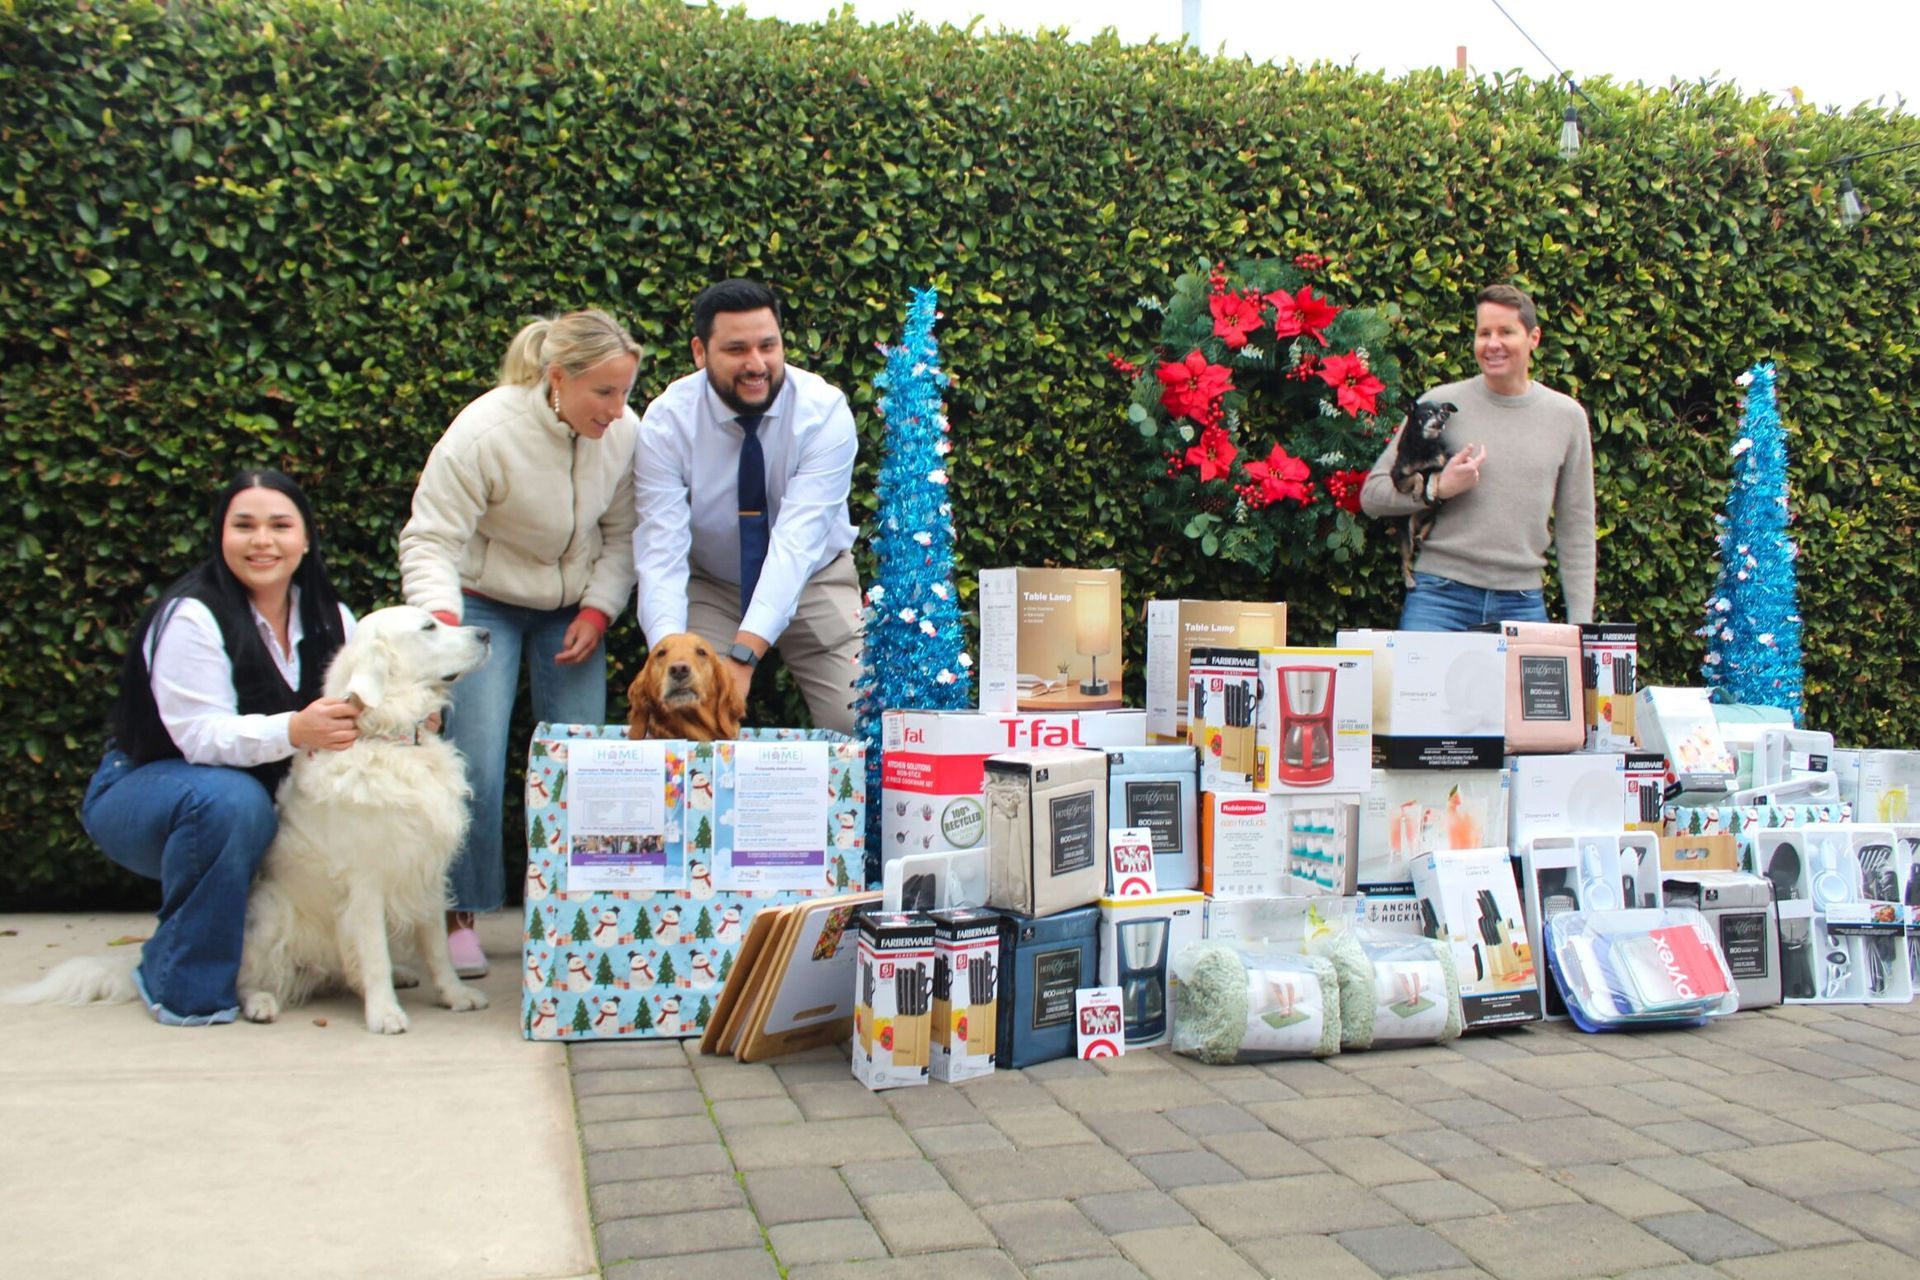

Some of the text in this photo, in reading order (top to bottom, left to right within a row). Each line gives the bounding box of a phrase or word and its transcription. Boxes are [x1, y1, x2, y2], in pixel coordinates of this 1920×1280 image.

[1023, 591, 1072, 603] Table Lamp
[1184, 622, 1235, 634] Table Lamp
[1602, 633, 1637, 641] FARBERWARE
[1211, 656, 1256, 667] FARBERWARE
[904, 728, 924, 743] fal
[1000, 719, 1086, 747] T-fal
[887, 760, 931, 773] KITCHEN SOLUTIONS
[1628, 761, 1663, 769] FARBERWARE
[1222, 804, 1264, 812] Rubbermaid
[944, 812, 982, 832] RECYCLED
[1060, 834, 1072, 844] 800
[1382, 902, 1419, 912] ANCHO
[1381, 913, 1421, 922] HOCKIN
[957, 925, 997, 939] FARBERWARE
[880, 936, 934, 948] FARBERWARE
[1043, 989, 1056, 999] 800
